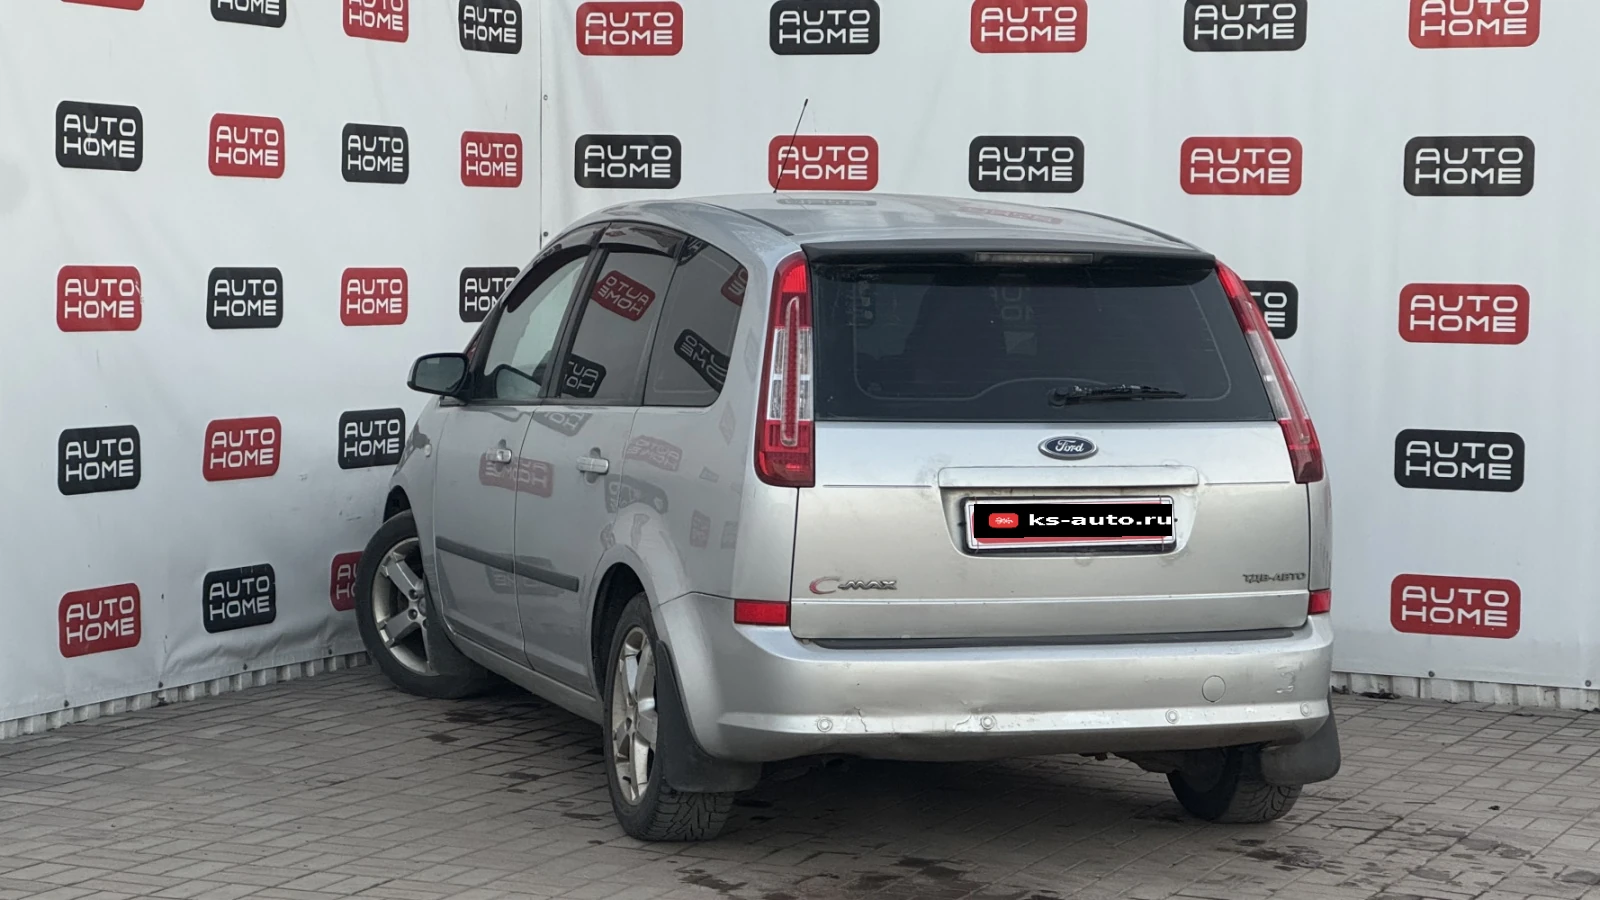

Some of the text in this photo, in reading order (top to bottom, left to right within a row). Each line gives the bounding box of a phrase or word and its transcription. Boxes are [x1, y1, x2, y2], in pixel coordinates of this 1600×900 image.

[464, 6, 516, 25] AUTO
[982, 7, 1077, 23] AUTO
[1195, 4, 1296, 20] AUTO
[1422, 0, 1528, 16] AUTO
[349, 8, 403, 31] HOME
[586, 12, 674, 27] AUTO
[780, 10, 870, 25] AUTO
[464, 24, 516, 43] HOME
[981, 26, 1075, 42] HOME
[1194, 23, 1294, 40] HOME
[1421, 18, 1526, 36] HOME
[585, 30, 672, 44] HOME
[779, 28, 868, 44] HOME
[64, 114, 136, 136] AUTO
[217, 126, 278, 146] AUTO
[348, 135, 403, 153] AUTO
[64, 136, 135, 158] HOME
[466, 142, 517, 158] AUTO
[585, 145, 672, 160] AUTO
[778, 146, 868, 161] AUTO
[979, 147, 1074, 162] AUTO
[216, 147, 278, 166] HOME
[348, 154, 403, 172] HOME
[1191, 148, 1291, 164] AUTO
[1416, 148, 1523, 164] AUTO
[466, 160, 516, 176] HOME
[584, 163, 670, 178] HOME
[778, 164, 867, 180] HOME
[979, 166, 1072, 181] HOME
[1191, 168, 1289, 184] HOME
[1415, 168, 1521, 184] HOME
[65, 279, 134, 296] AUTO
[215, 280, 277, 296] AUTO
[347, 279, 402, 294] AUTO
[65, 300, 134, 318] HOME
[214, 300, 276, 316] HOME
[347, 298, 402, 314] HOME
[1411, 295, 1518, 312] AUTO
[1410, 315, 1516, 332] HOME
[345, 419, 400, 438] AUTO
[212, 428, 275, 448] AUTO
[1055, 440, 1084, 452] Ford
[66, 438, 134, 460] AUTO
[344, 438, 399, 457] HOME
[1406, 441, 1513, 460] AUTO
[210, 448, 274, 469] HOME
[66, 459, 133, 482] HOME
[1406, 460, 1511, 480] HOME
[210, 576, 269, 600] AUTO
[1402, 586, 1509, 606] AUTO
[66, 596, 134, 622] AUTO
[210, 596, 270, 620] HOME
[1402, 605, 1507, 626] HOME
[66, 617, 134, 644] HOME
